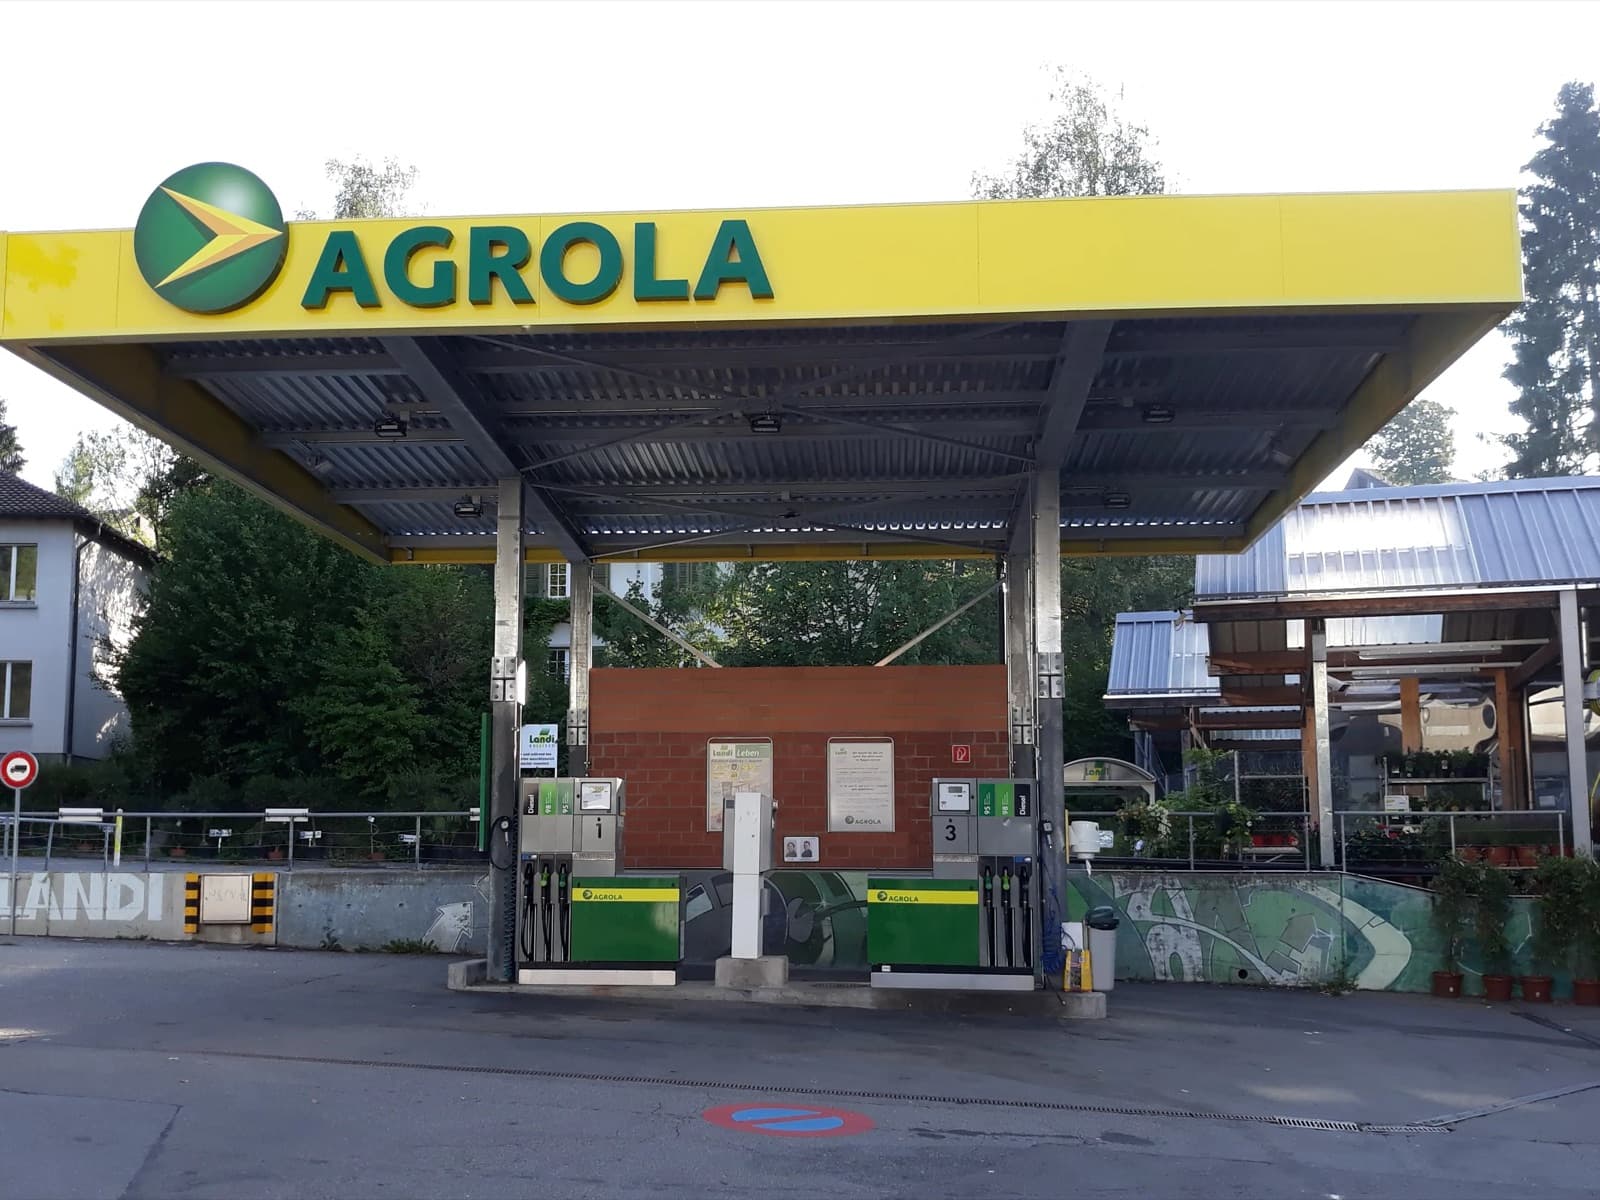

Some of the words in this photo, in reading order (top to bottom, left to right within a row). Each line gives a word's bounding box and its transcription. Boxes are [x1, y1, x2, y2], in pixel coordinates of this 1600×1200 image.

[301, 219, 774, 309] AGROLA
[529, 734, 555, 743] Landi
[736, 749, 760, 757] Leben
[563, 805, 569, 814] 95
[984, 806, 990, 815] 95
[1002, 806, 1009, 815] 98
[945, 825, 956, 841] 3
